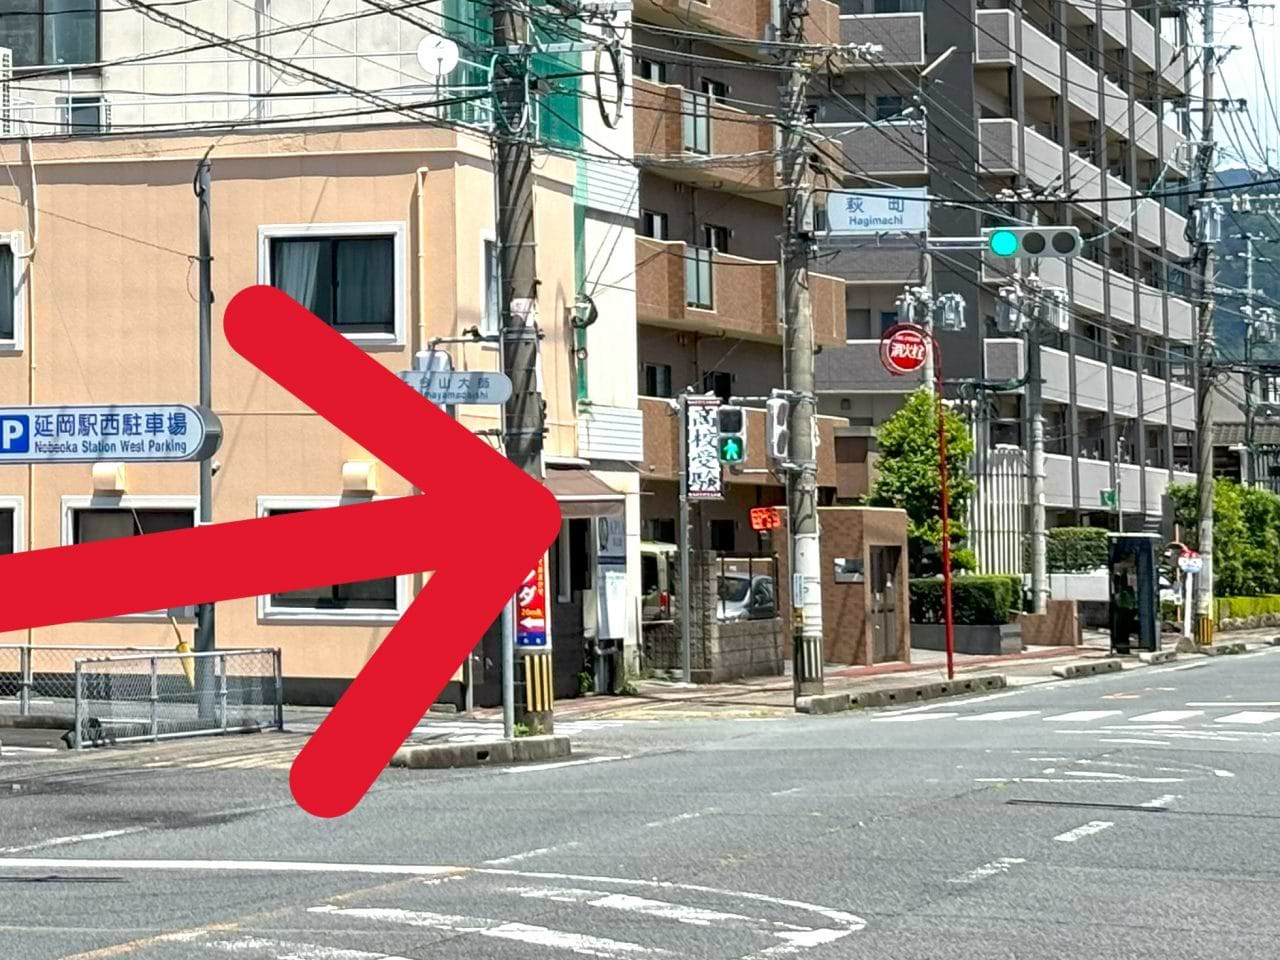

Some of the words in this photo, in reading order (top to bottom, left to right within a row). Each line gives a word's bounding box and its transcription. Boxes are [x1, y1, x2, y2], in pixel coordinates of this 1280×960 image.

[849, 214, 904, 227] Hagimachi
[890, 341, 926, 360] 消火栓
[34, 412, 187, 437] 延岡駅西駐車場
[2, 420, 24, 450] P
[34, 441, 78, 454] Nobeoka
[82, 440, 117, 454] Station
[120, 440, 145, 453] West
[148, 439, 187, 454] Parking
